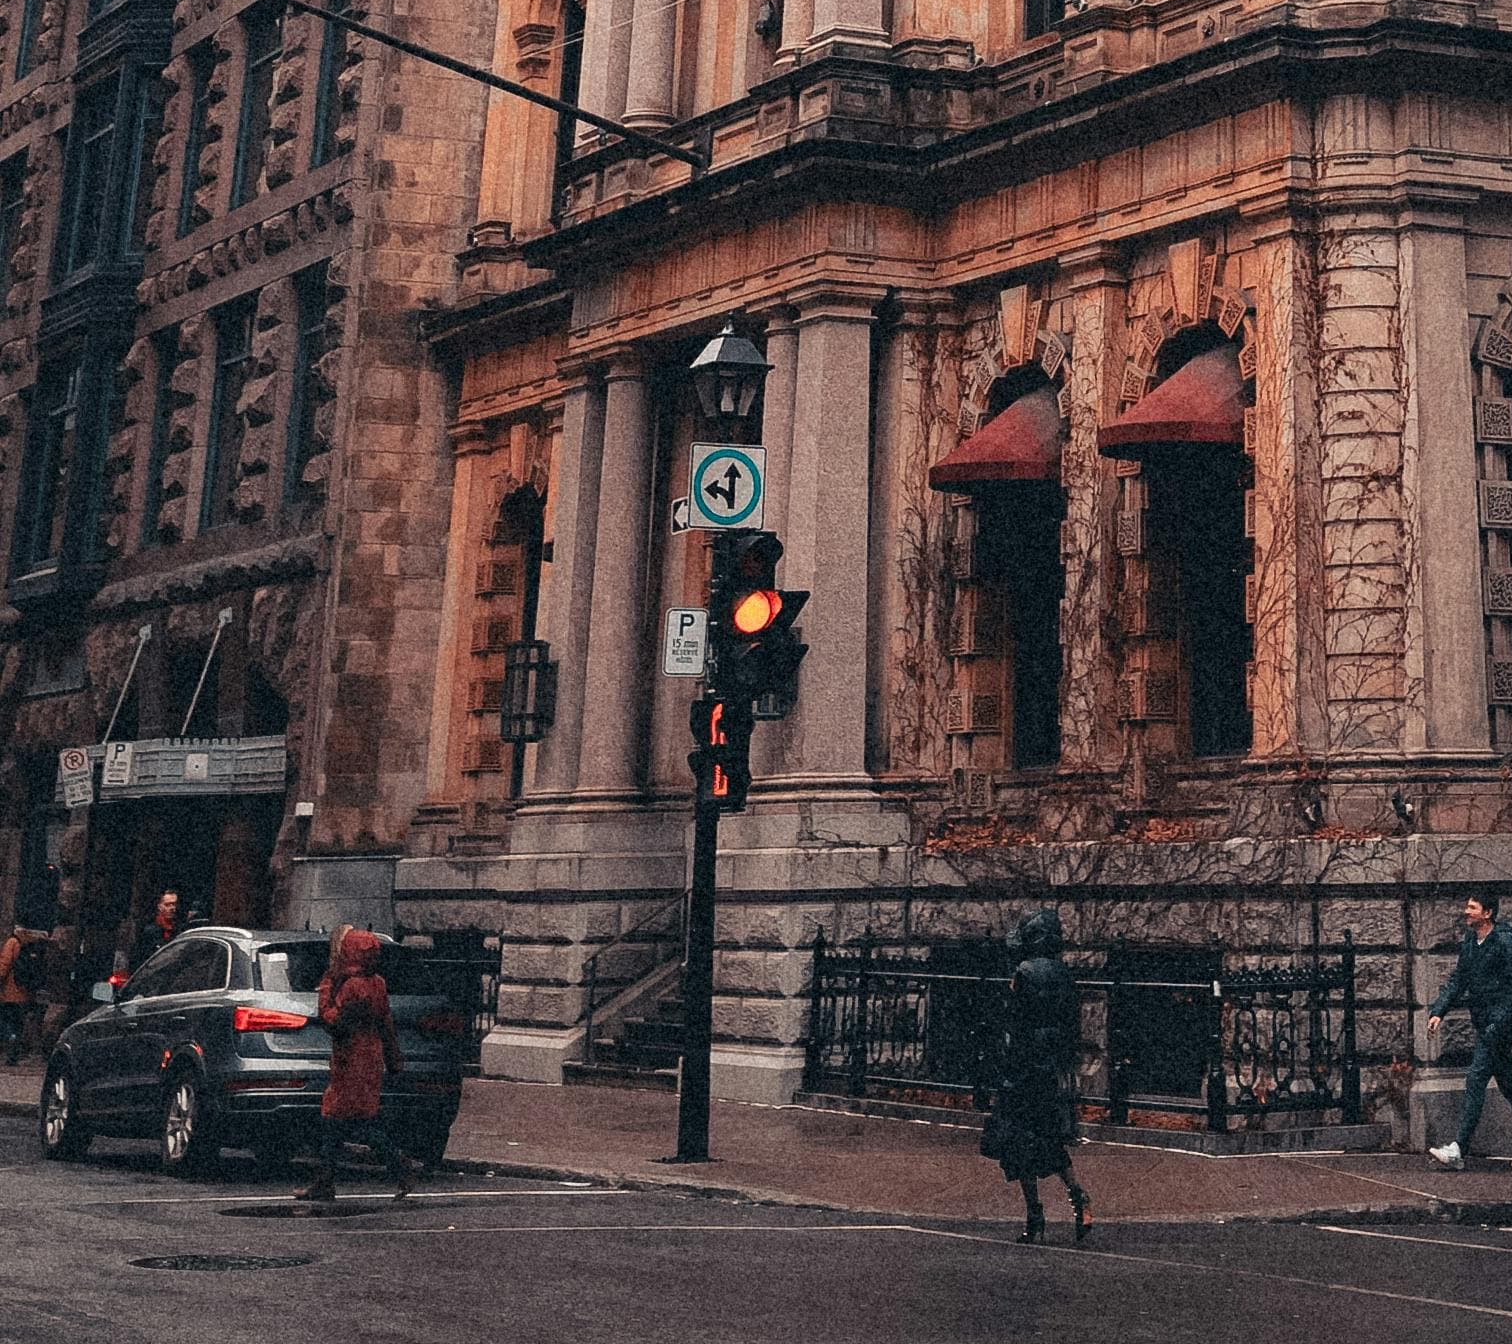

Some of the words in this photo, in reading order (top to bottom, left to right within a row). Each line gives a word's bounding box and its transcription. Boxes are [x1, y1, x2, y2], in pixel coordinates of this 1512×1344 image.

[679, 614, 694, 636] P
[672, 638, 681, 648] 15
[114, 744, 125, 759] P
